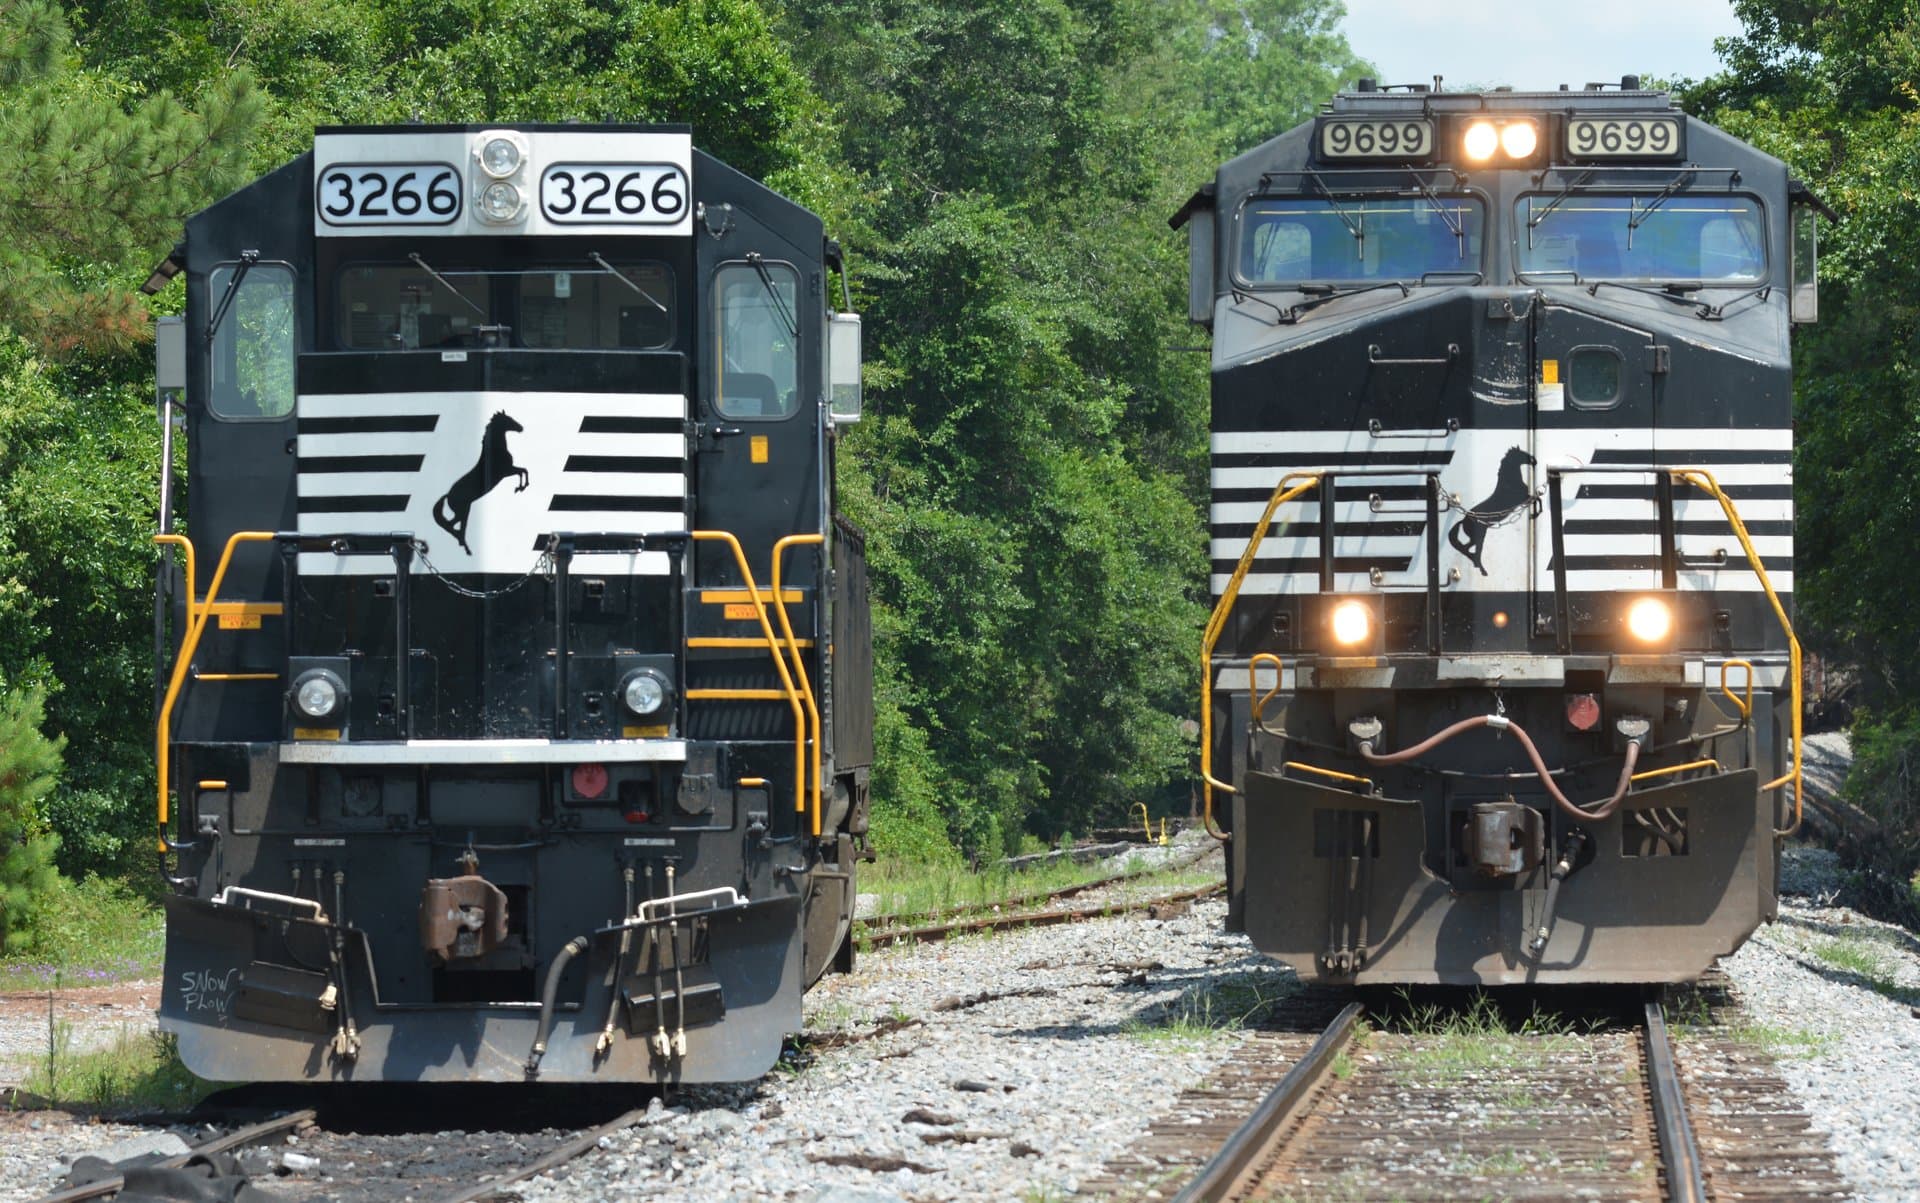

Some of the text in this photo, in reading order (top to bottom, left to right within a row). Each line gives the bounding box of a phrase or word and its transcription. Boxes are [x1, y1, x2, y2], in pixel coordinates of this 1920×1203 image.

[1330, 122, 1424, 153] 9699
[1576, 122, 1670, 152] 9699
[325, 172, 457, 217] 3266
[547, 171, 682, 216] 3266
[180, 967, 238, 992] SNOW
